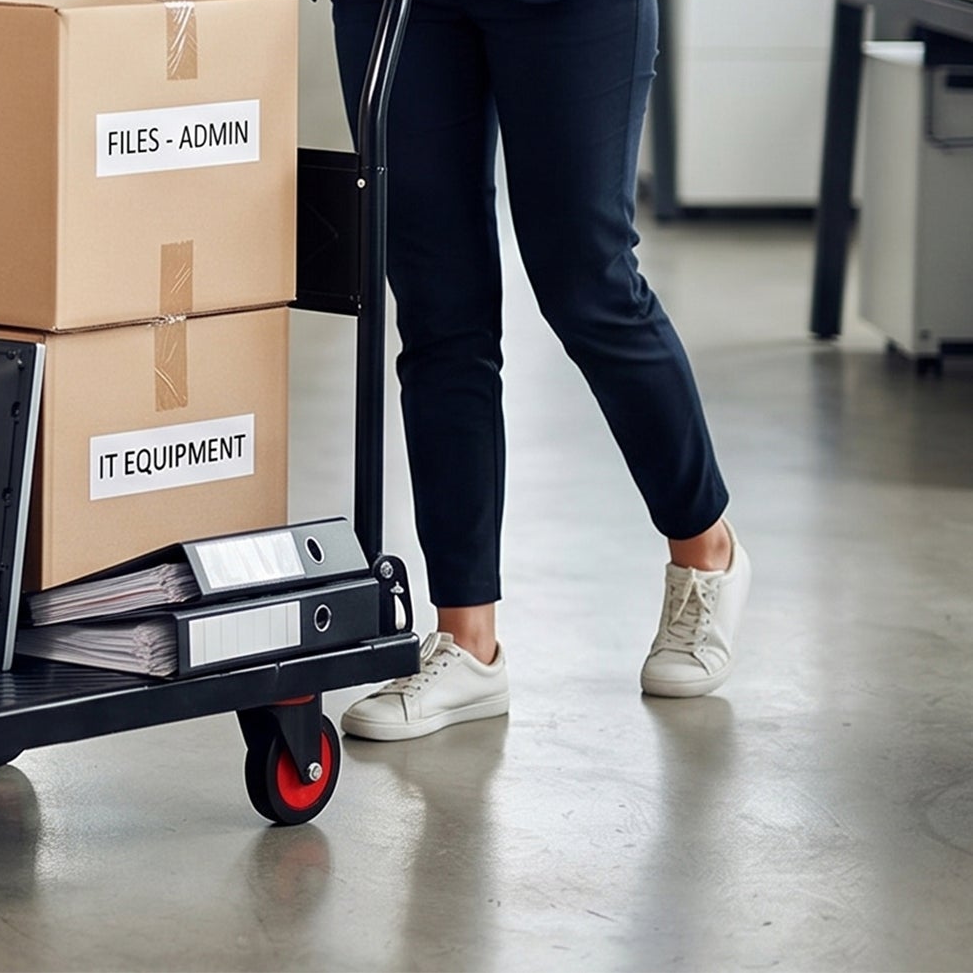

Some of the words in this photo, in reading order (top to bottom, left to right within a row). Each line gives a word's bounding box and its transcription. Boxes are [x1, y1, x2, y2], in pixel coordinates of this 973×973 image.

[108, 127, 160, 156] FILES
[179, 120, 249, 150] ADMIN
[99, 453, 118, 479] IT
[124, 434, 246, 475] EQUIPMENT
